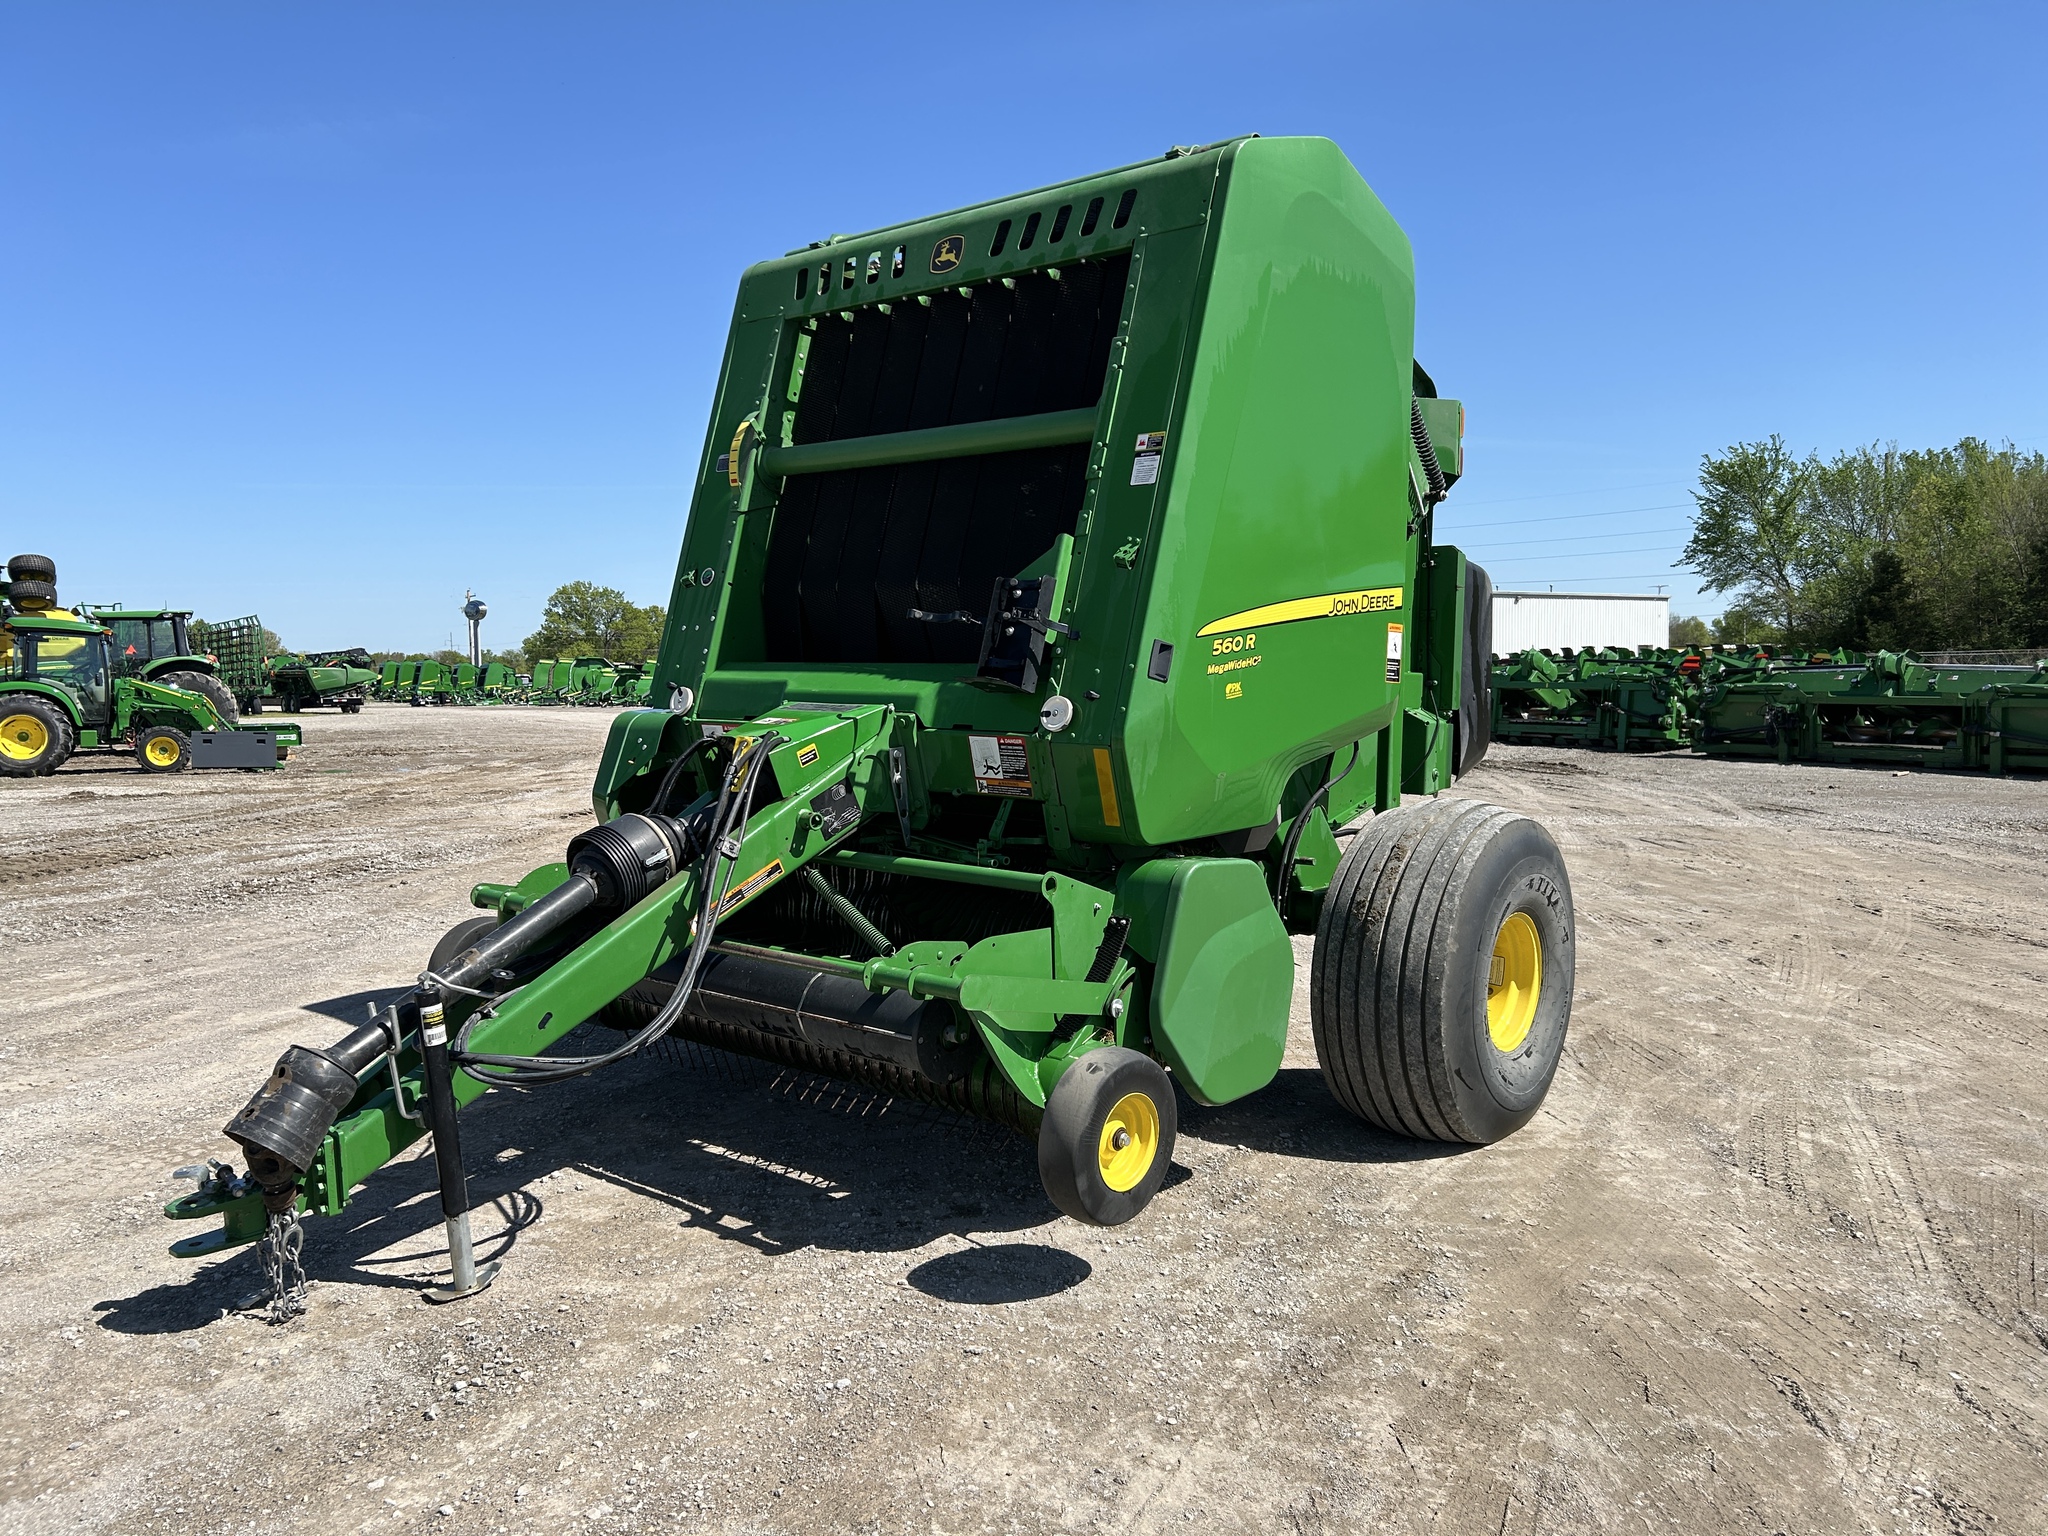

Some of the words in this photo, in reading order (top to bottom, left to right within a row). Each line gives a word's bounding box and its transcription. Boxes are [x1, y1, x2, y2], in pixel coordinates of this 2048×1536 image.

[1328, 597, 1359, 614] JOHN
[1361, 594, 1395, 610] DEERE
[1212, 635, 1244, 656] 560
[1245, 633, 1256, 650] R
